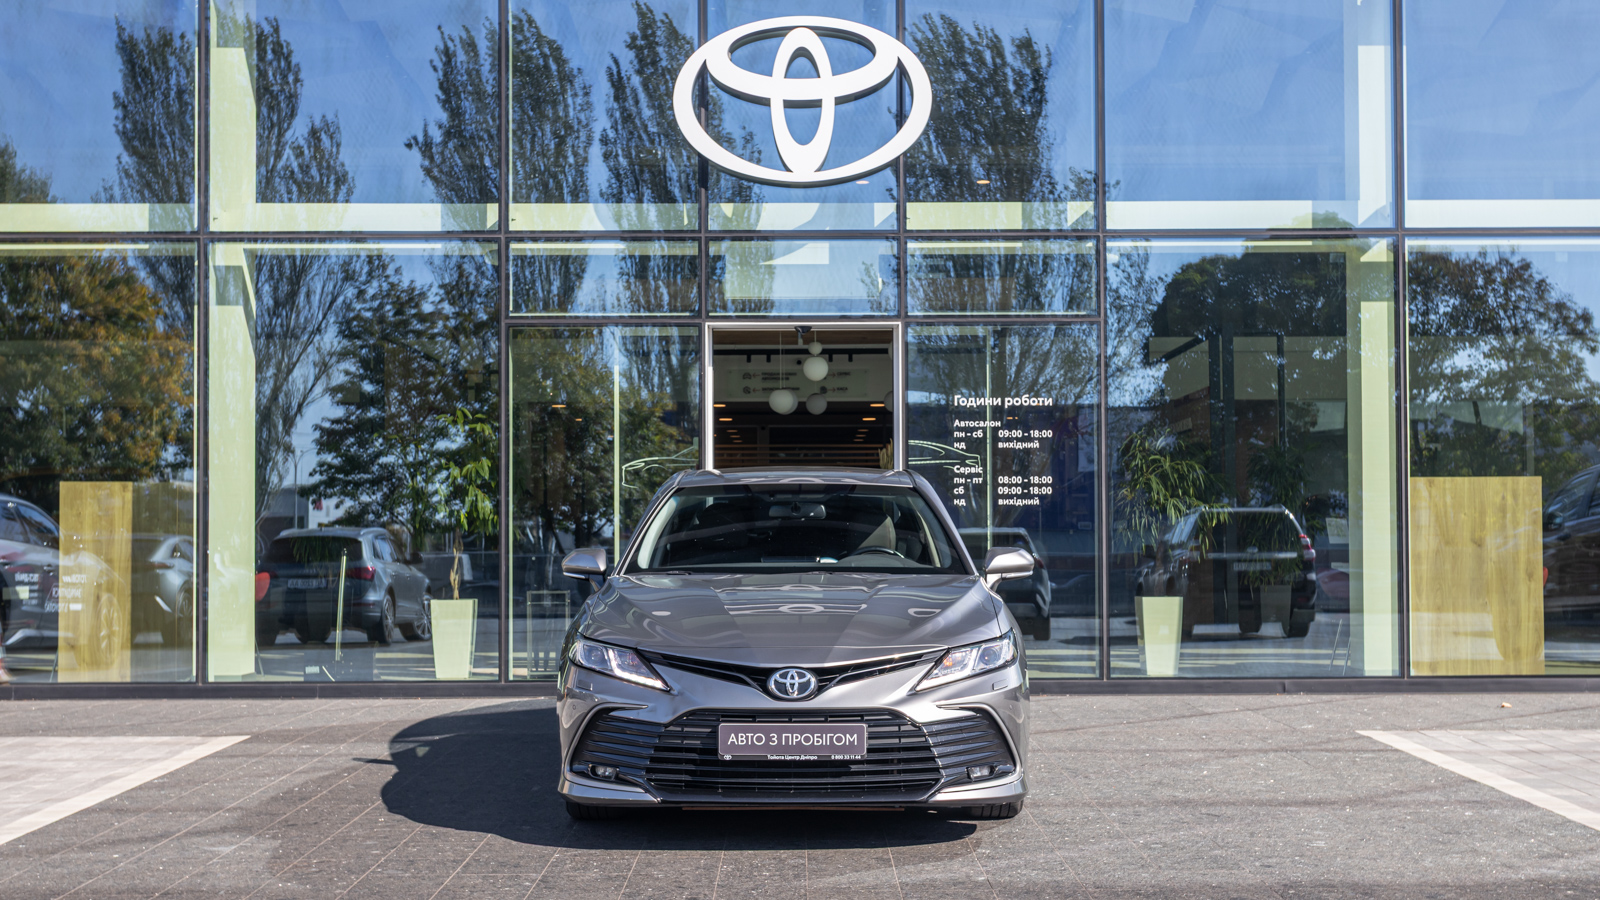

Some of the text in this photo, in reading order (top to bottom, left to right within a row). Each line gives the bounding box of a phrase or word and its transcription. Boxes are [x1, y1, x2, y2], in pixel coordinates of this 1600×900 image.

[954, 394, 1053, 408] Години роботи
[972, 429, 983, 438] сб
[998, 430, 1022, 438] 09:00
[1030, 430, 1053, 438] 18:00
[998, 440, 1040, 449] вихідний
[953, 465, 983, 475] Сервіс
[998, 476, 1022, 484] 08:00
[1030, 476, 1053, 484] 18:00
[954, 486, 965, 495] сб
[998, 486, 1022, 495] 09:00
[1030, 486, 1053, 495] 18:00
[954, 497, 1040, 506] нд вихідний
[728, 734, 858, 746] АВТО З ПРОБІГОМ
